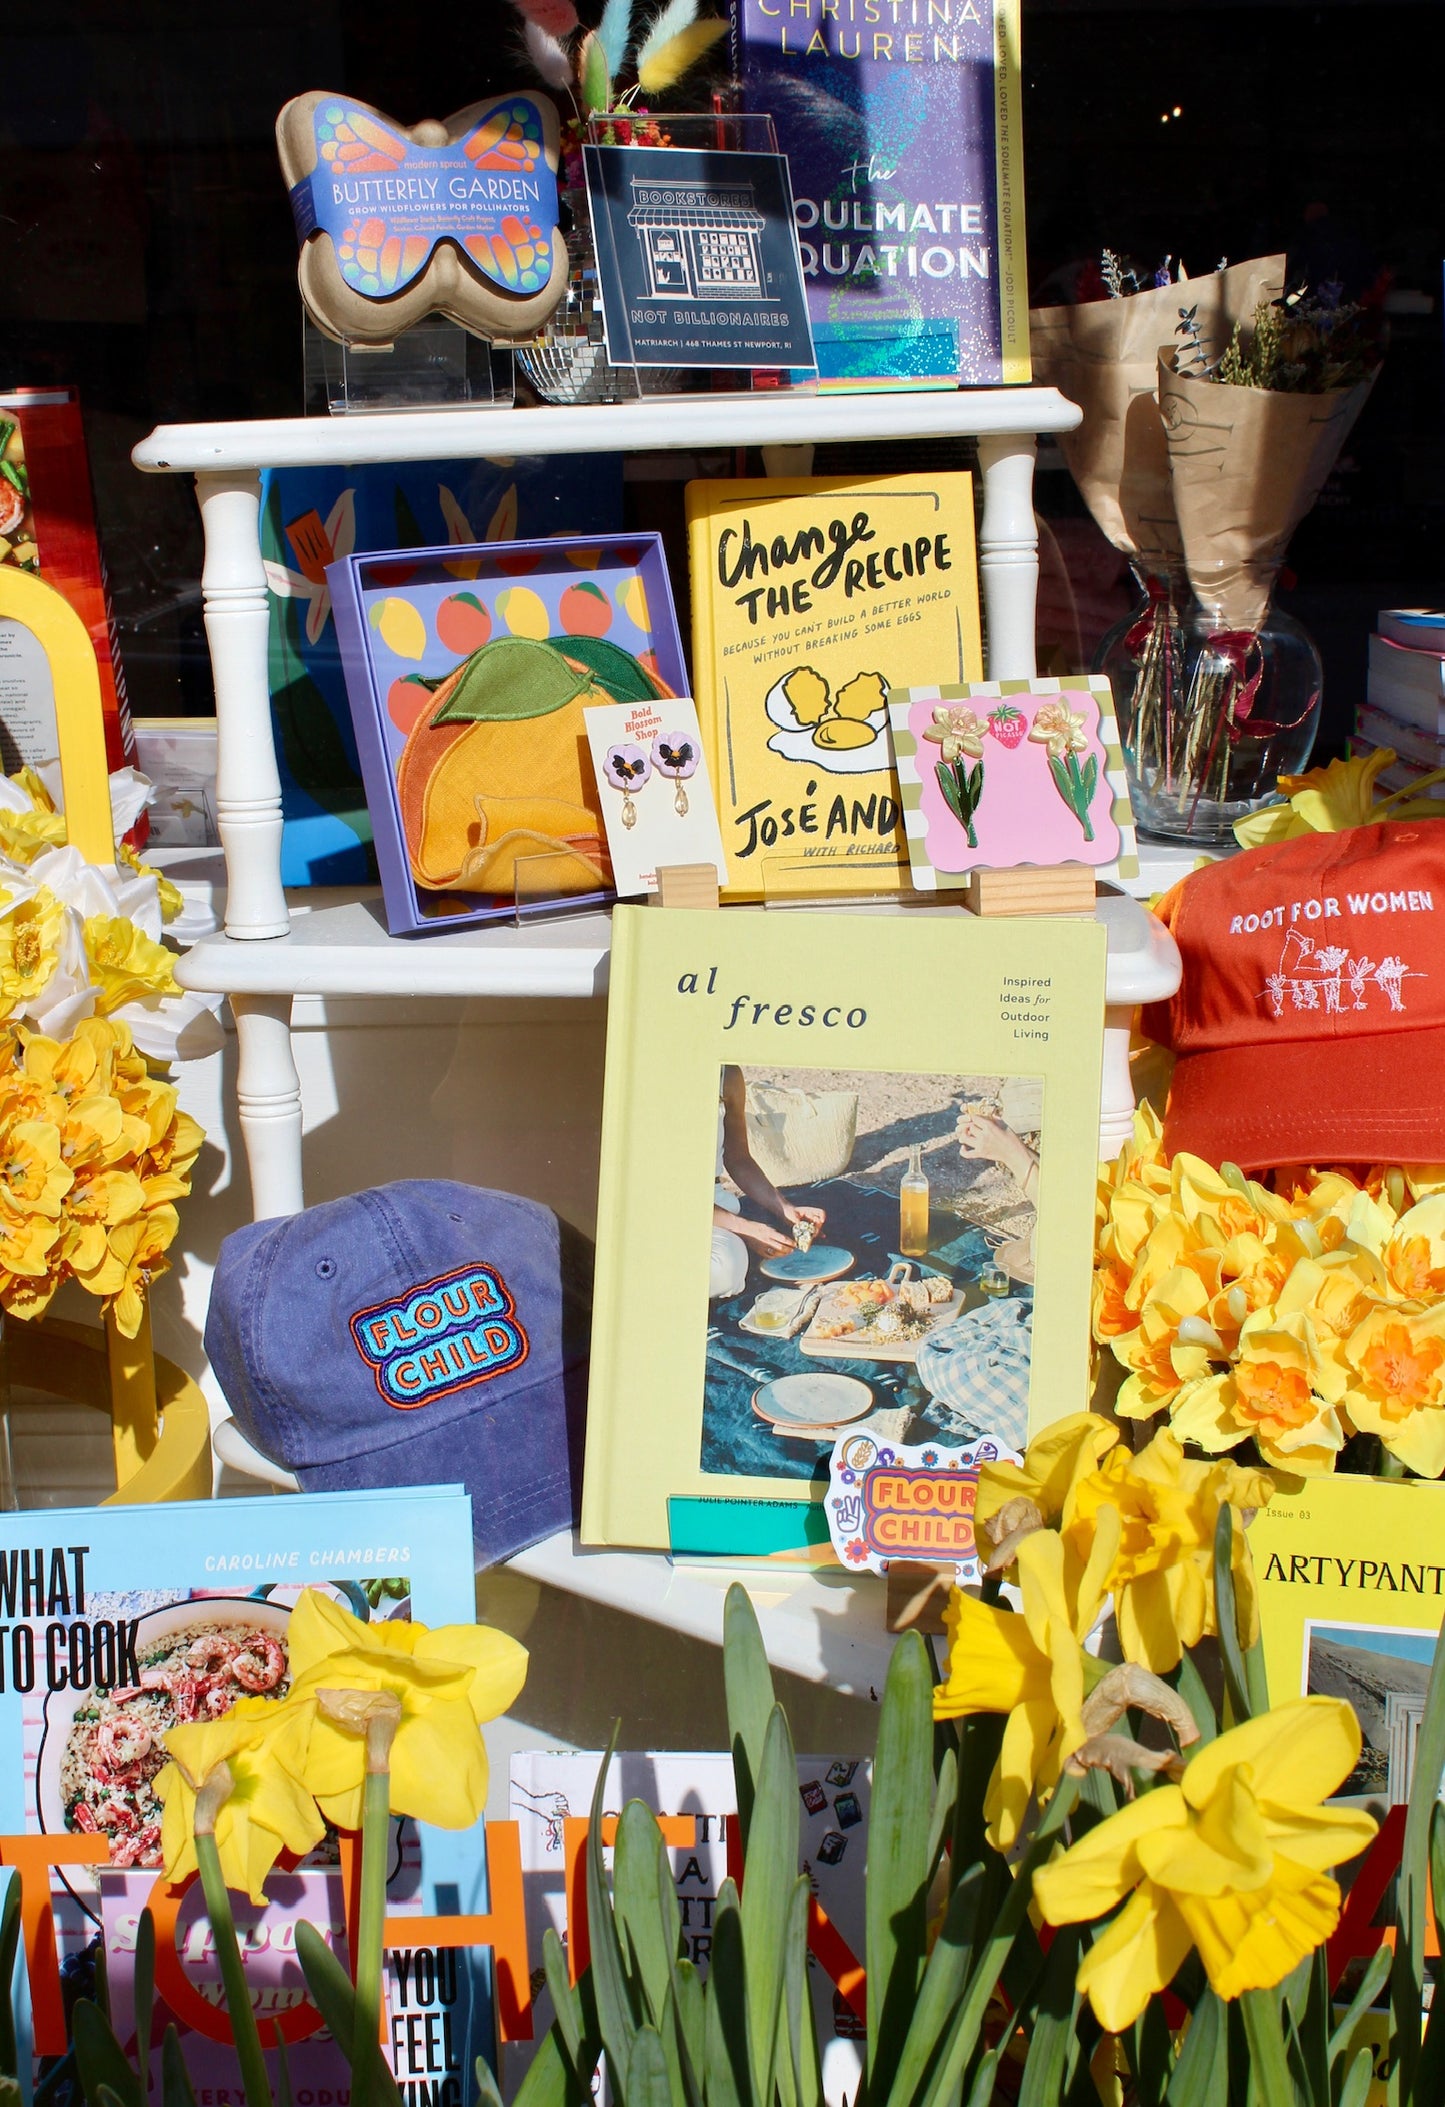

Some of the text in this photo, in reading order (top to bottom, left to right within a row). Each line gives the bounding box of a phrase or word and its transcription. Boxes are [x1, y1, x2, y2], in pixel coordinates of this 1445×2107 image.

[758, 0, 981, 26] CHRISTINA
[781, 26, 959, 63] LAUREN
[999, 86, 1008, 121] LOVED
[1001, 125, 1009, 143] THE
[404, 160, 467, 170] modern sprout
[841, 155, 897, 194] the
[1001, 146, 1011, 199] SOULMATE
[332, 177, 540, 204] BUTTERFLY GARDEN
[638, 189, 751, 208] BOOKSTORES
[348, 206, 377, 215] GROW
[379, 203, 447, 213] WILDFLOWERS
[470, 203, 531, 212] POLLINATORS
[793, 198, 985, 234] OULMATE
[799, 241, 990, 280] QUATION
[630, 310, 790, 327] NOT BILLIONAIRES
[1006, 300, 1016, 344] PICOULT
[634, 338, 678, 347] MATRIARCH
[700, 340, 731, 348] THAMES
[733, 340, 742, 348] ST
[744, 341, 783, 350] NEWPORT,
[718, 511, 875, 589] Change
[734, 533, 952, 625] THE RECIPE
[722, 589, 952, 657] BECAUSE YOU CAN'T BUILD A BETTER WORLD
[753, 610, 921, 665] WITHOUT BREAKING SOME EGGS
[624, 716, 663, 733] Blossom
[631, 706, 652, 720] Bold
[993, 720, 1021, 733] NOT
[635, 728, 659, 741] Shop
[734, 779, 905, 858] JOSÉ AND
[803, 841, 900, 857] WITH RICHARD
[1229, 890, 1434, 934] ROOT FOR WOMEN
[677, 966, 718, 995] al
[1003, 976, 1051, 988] Inspired
[723, 994, 868, 1031] fresco
[1000, 993, 1051, 1006] Ideas for
[1000, 1011, 1050, 1022] Outdoor
[1013, 1028, 1049, 1042] Living
[369, 1279, 498, 1350] FLOUR
[394, 1326, 511, 1390] CHILD
[699, 1496, 721, 1505] JULIE
[724, 1497, 764, 1507] POINTER
[766, 1500, 798, 1509] ADAMS
[878, 1481, 976, 1508] FLOUR
[1265, 1508, 1294, 1519] Issue
[879, 1518, 972, 1544] CHILD
[205, 1545, 412, 1572] CAROLINE CHAMBERS
[0, 1546, 90, 1618] WHAT
[46, 1619, 142, 1692] COOK
[393, 1947, 457, 2008] YOU
[392, 2011, 461, 2076] FEEL
